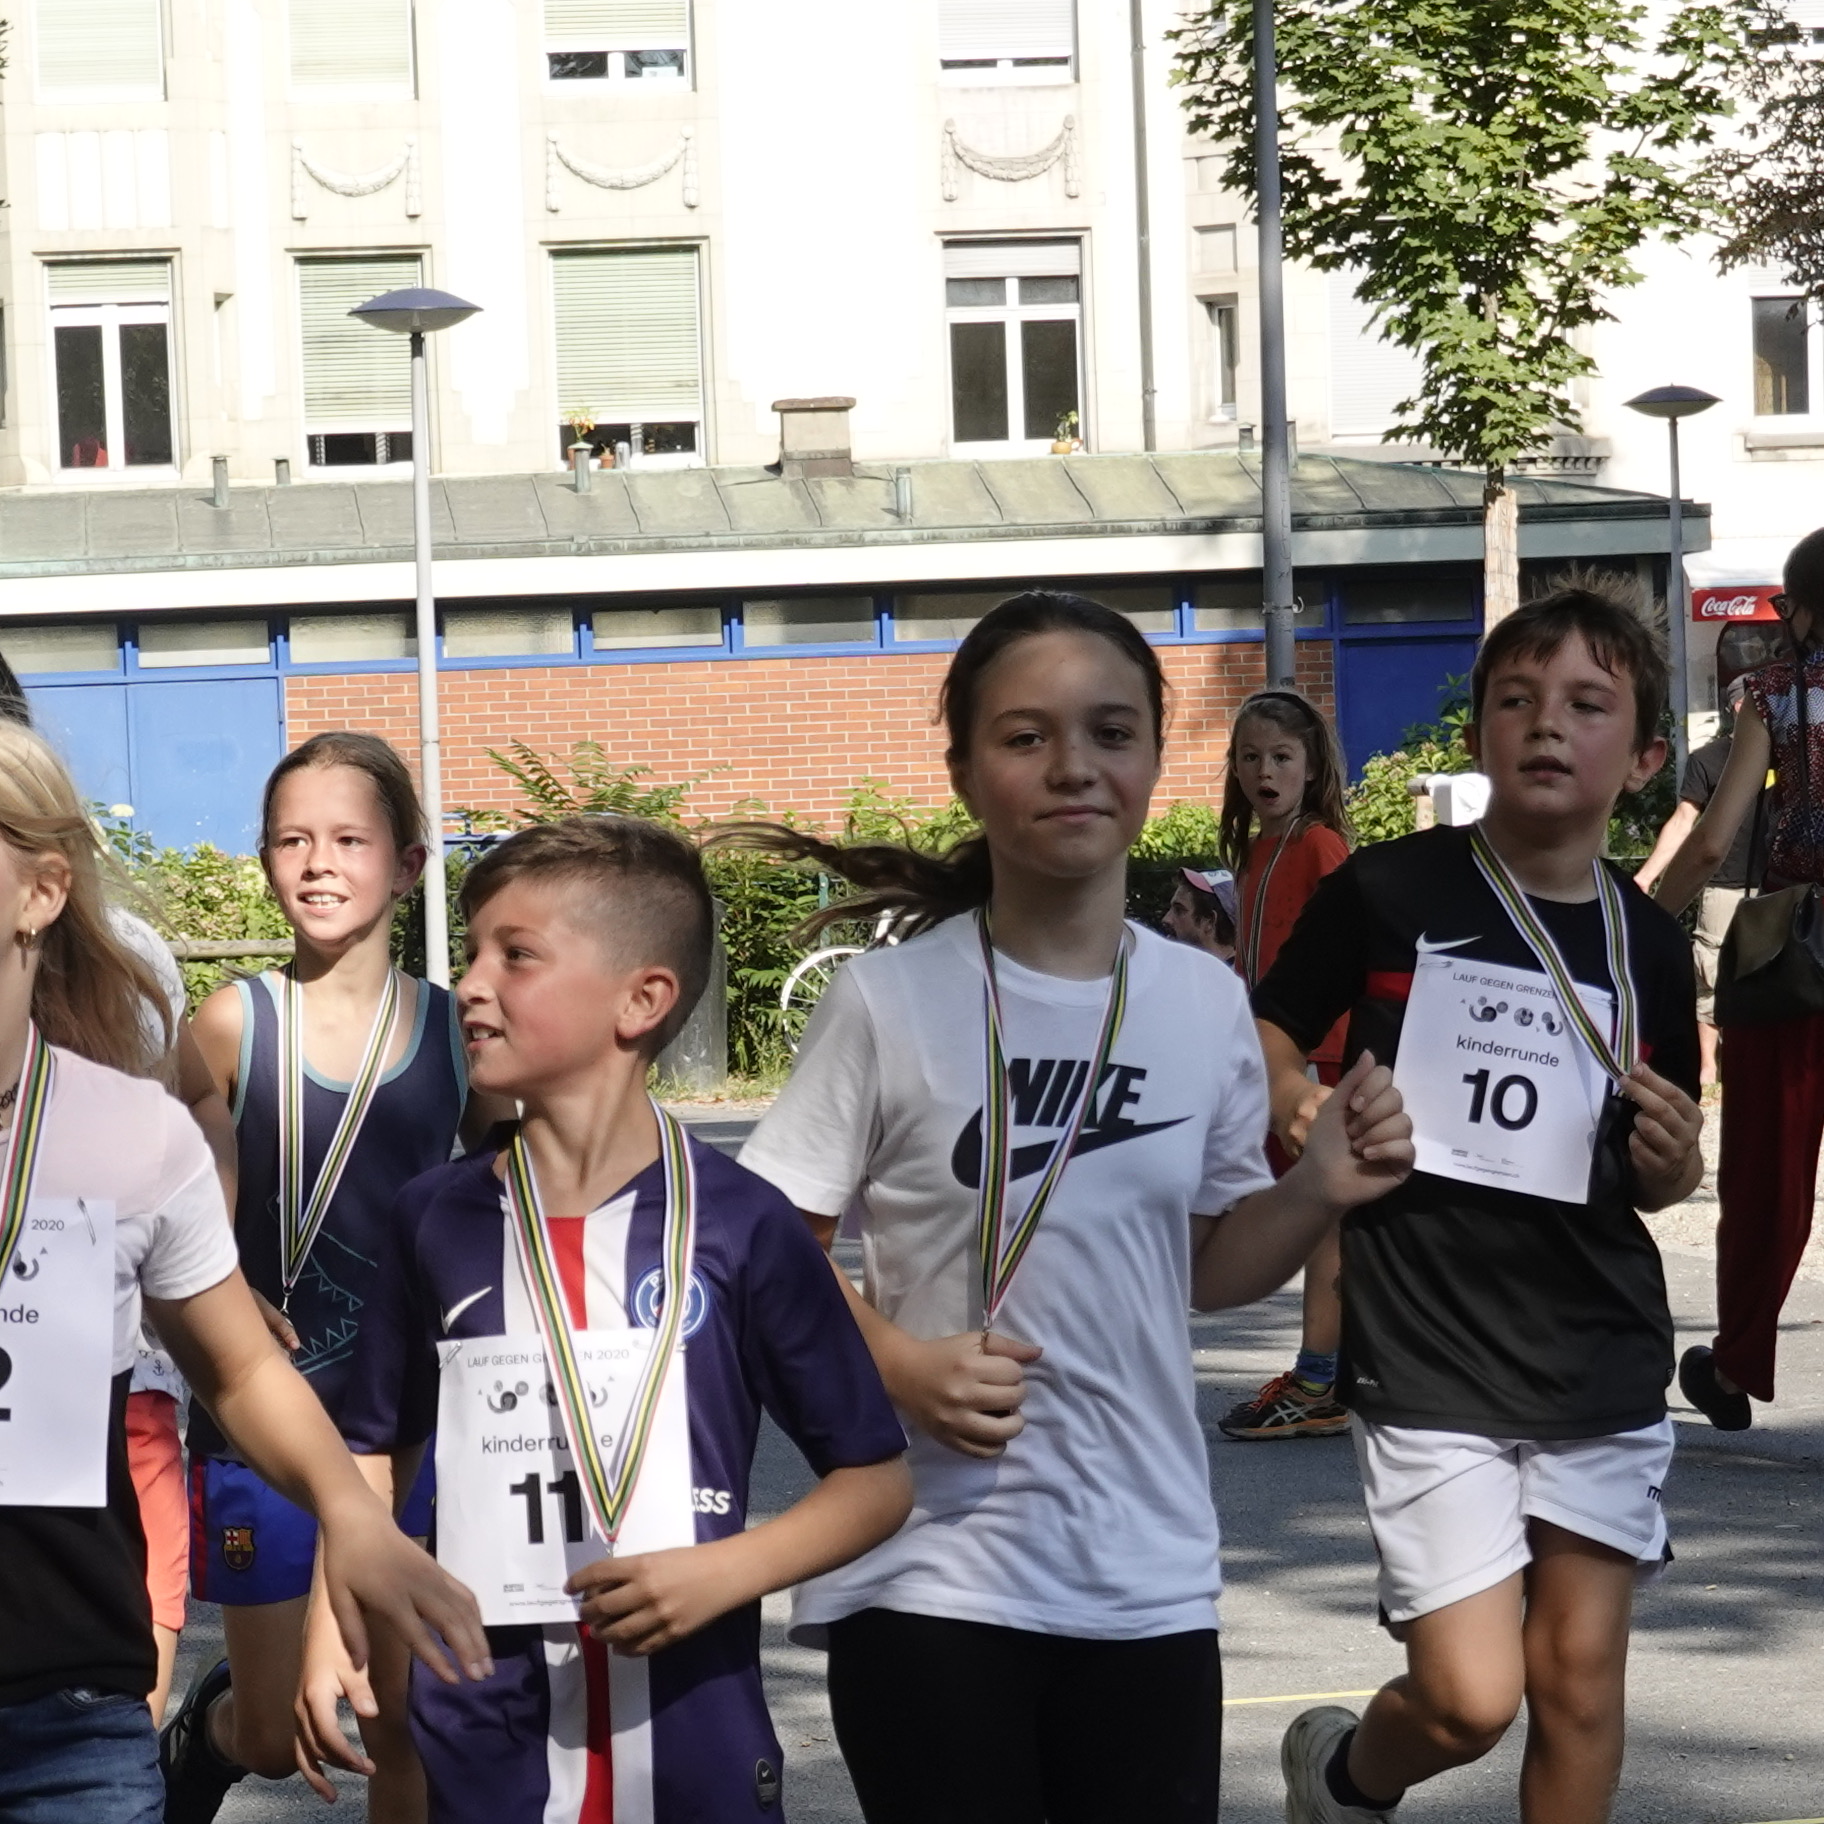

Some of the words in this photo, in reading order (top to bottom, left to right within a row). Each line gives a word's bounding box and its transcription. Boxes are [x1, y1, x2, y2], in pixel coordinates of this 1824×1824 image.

[1701, 595, 1758, 616] Coca-Cola
[1453, 972, 1478, 984] LAUF
[1480, 977, 1514, 990] GEGEN
[1456, 1034, 1559, 1067] kinderrunde
[1007, 1058, 1147, 1127] NIKE
[1461, 1068, 1539, 1131] 10
[32, 1219, 65, 1231] 2020
[468, 1356, 489, 1368] LAUF
[492, 1354, 528, 1366] GEGEN
[596, 1349, 629, 1360] 2020
[482, 1434, 613, 1454] kinderrue
[510, 1471, 584, 1545] 11
[692, 1488, 730, 1515] ESS
